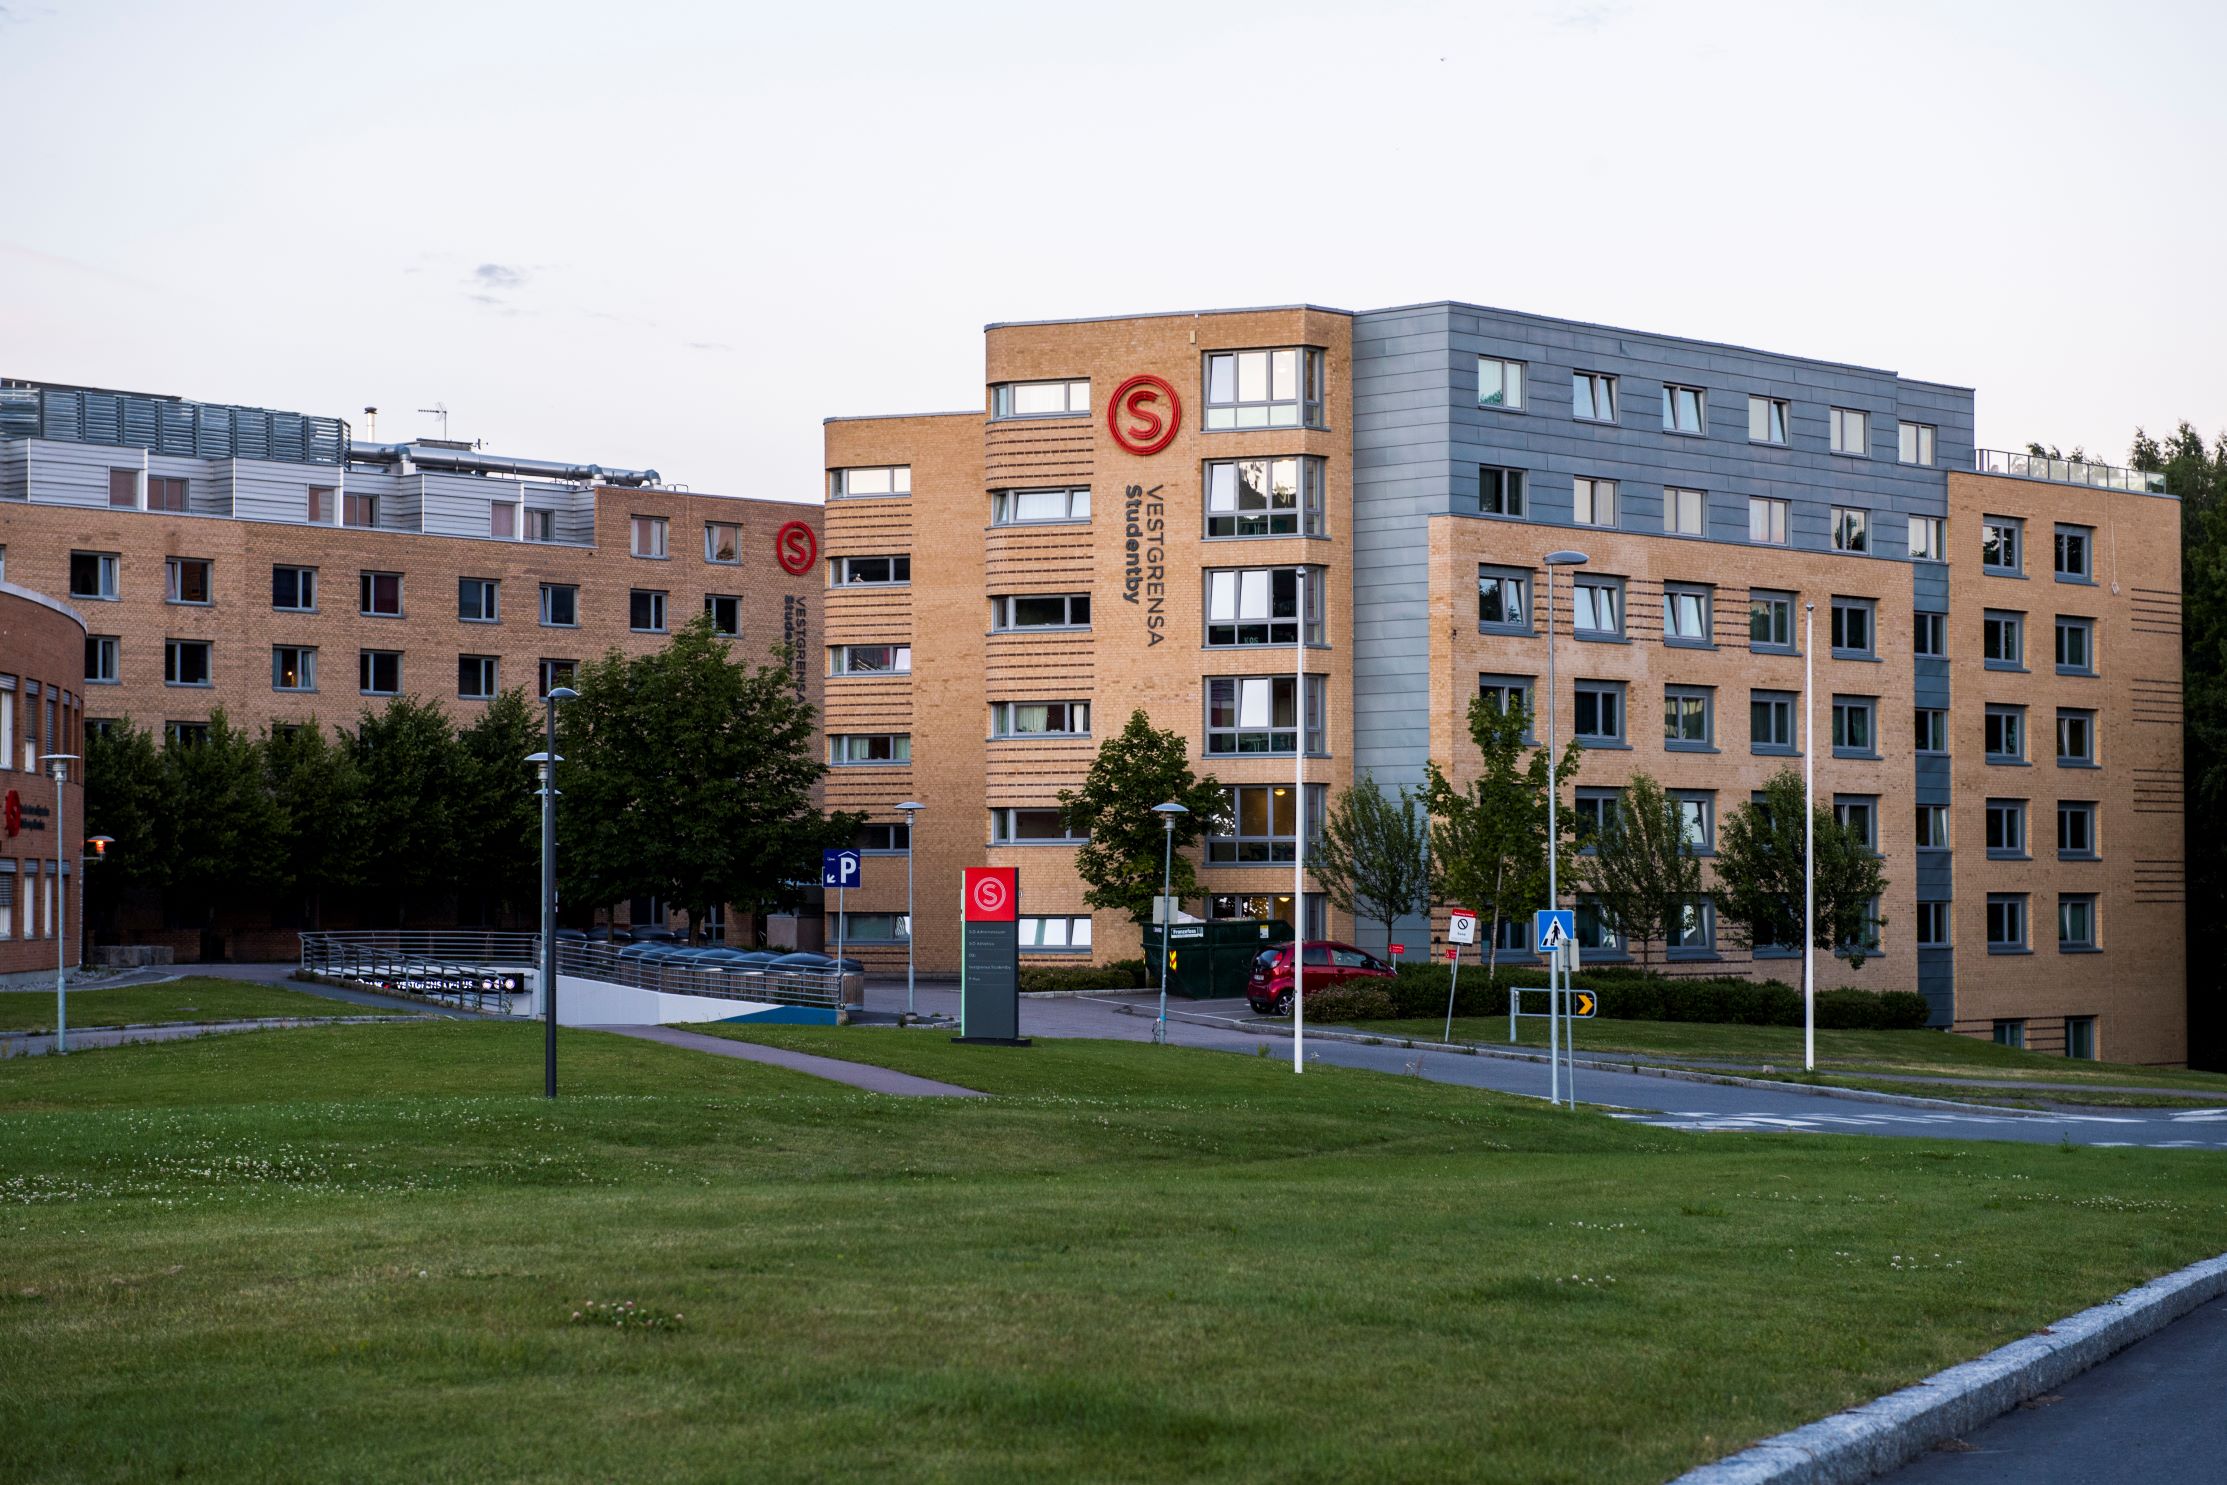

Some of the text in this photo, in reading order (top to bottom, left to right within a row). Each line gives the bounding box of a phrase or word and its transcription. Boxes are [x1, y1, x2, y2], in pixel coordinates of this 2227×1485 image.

[1123, 485, 1143, 605] Studentby
[1147, 484, 1164, 647] VESTGRENSA
[795, 596, 806, 704] VESTGRENSA
[841, 857, 857, 884] P
